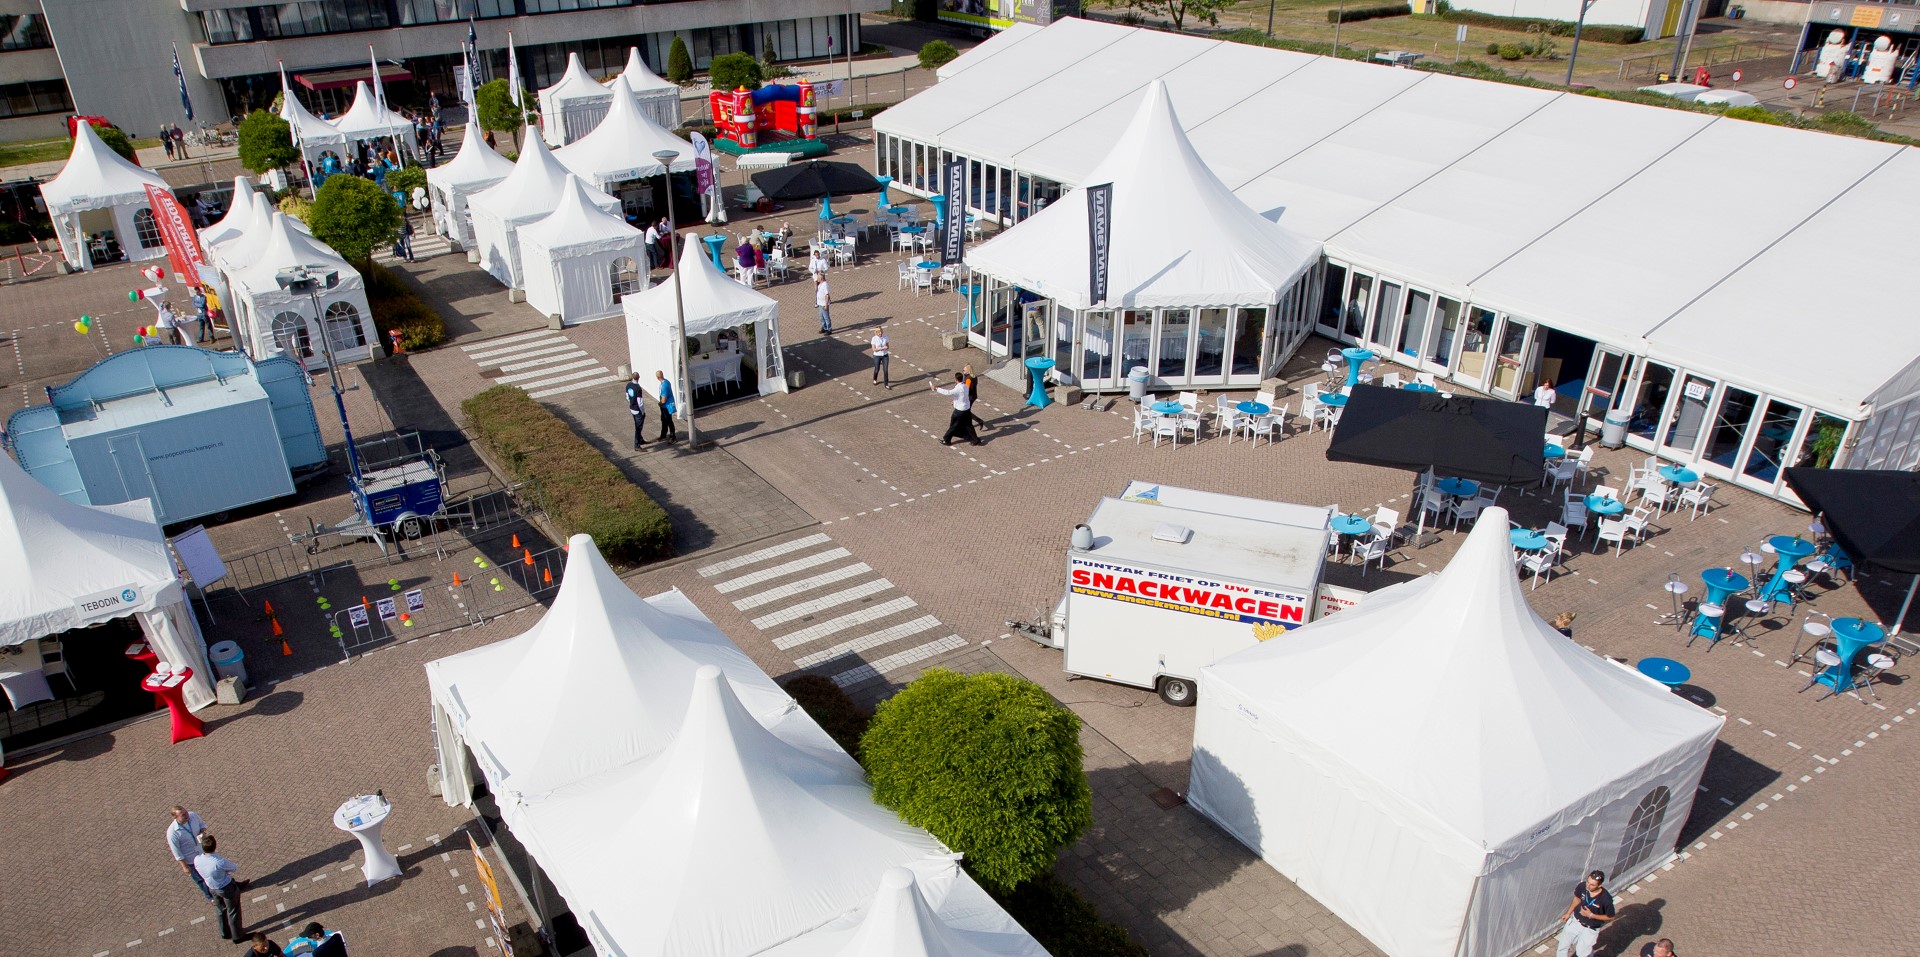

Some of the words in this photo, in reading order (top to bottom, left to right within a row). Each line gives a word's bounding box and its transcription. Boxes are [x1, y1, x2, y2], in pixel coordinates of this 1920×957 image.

[149, 441, 224, 461] www.popcornsukerspin.nl
[1072, 558, 1144, 576] PUNTZAK
[1149, 571, 1194, 584] FRIET
[1198, 580, 1221, 588] OP
[1225, 585, 1251, 593] UW
[1254, 589, 1306, 602] FEEST
[81, 596, 120, 612] TEBODIN
[1072, 569, 1304, 623] SNACKWAGEN
[1072, 586, 1241, 621] www.snackmobiel.nl
[1320, 595, 1358, 606] PUNTZA
